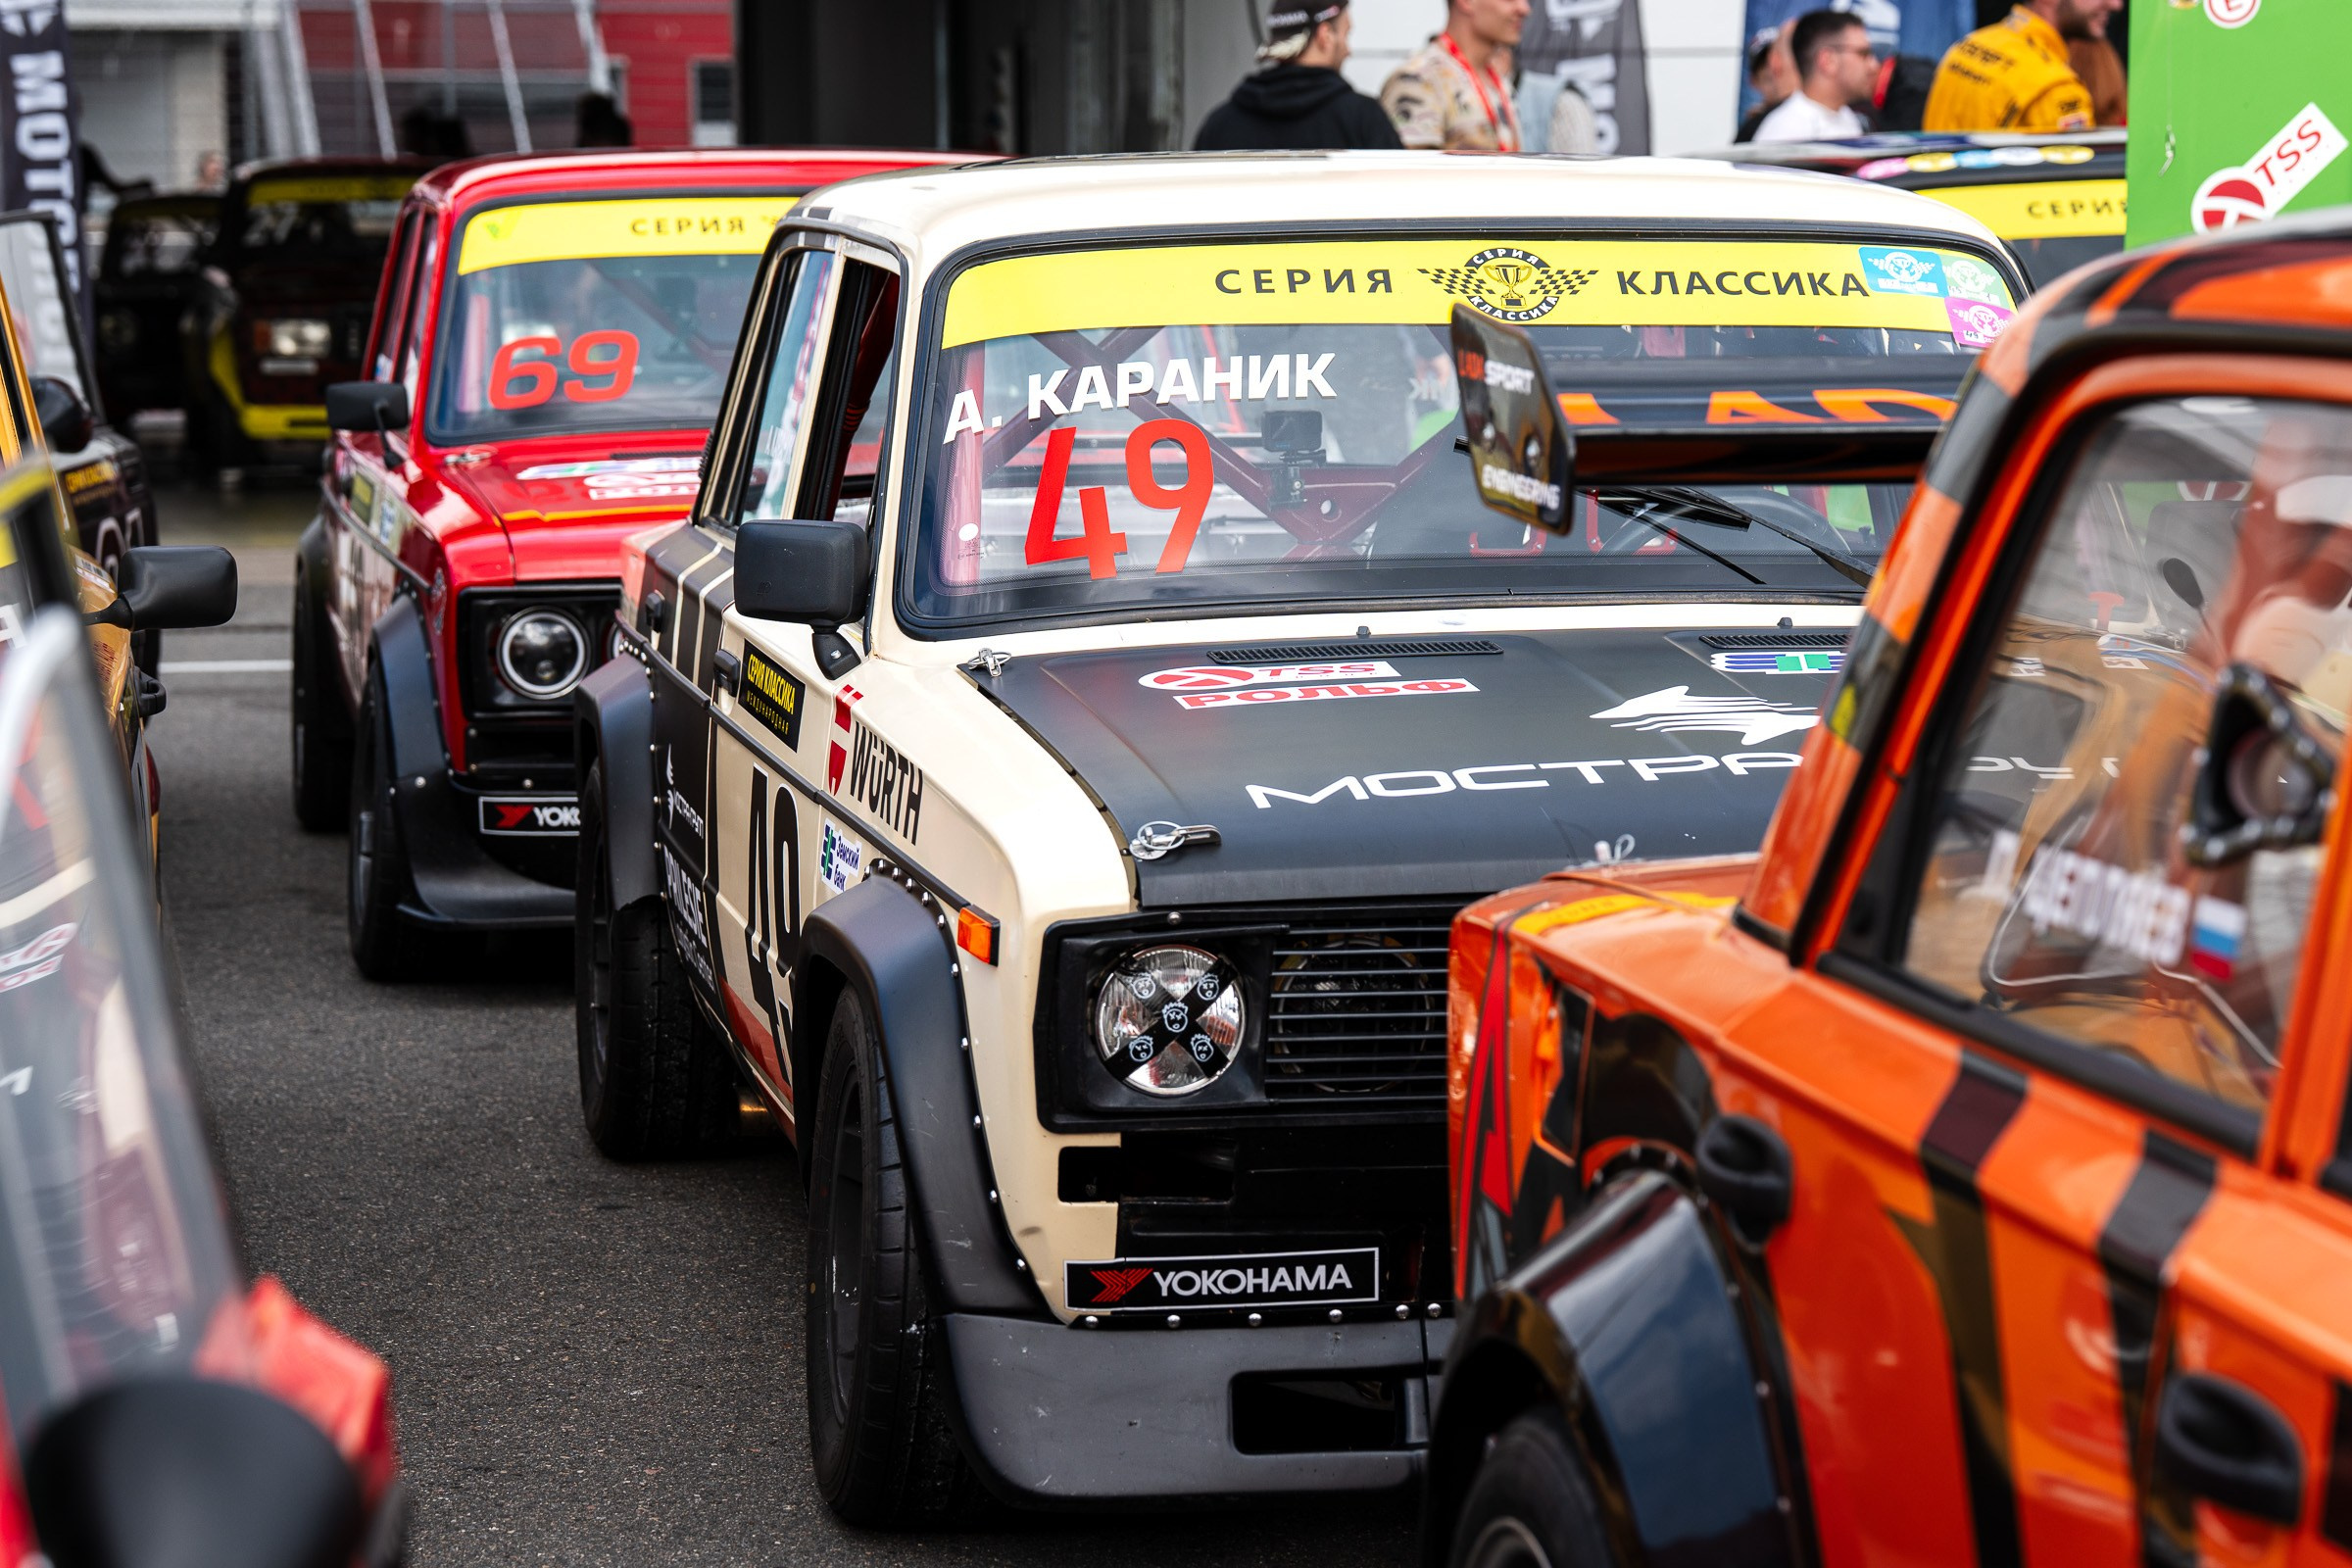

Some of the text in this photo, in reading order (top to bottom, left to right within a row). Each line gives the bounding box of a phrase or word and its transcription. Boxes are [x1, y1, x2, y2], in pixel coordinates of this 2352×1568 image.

[2254, 119, 2322, 186] TSS
[2027, 199, 2128, 218] СЕРИ
[631, 218, 745, 235] СЕРИЯ
[1473, 248, 1540, 266] СЕРИЯ
[1215, 269, 1394, 294] СЕРИЯ
[1617, 270, 1870, 297] КЛАССИКА
[1470, 295, 1558, 321] КЛАССИКА
[487, 328, 640, 410] 69
[943, 352, 1337, 444] А. КАРАНИК
[1024, 418, 1214, 580] 49
[748, 654, 795, 714] СЕРИЯ КЛАССИКА
[1258, 664, 1375, 676] TSS
[1182, 680, 1467, 707] РОЛЬФ
[850, 720, 923, 846] WÜRTH
[837, 835, 859, 870] Земский
[1153, 1263, 1353, 1298] YOKOHAMA
